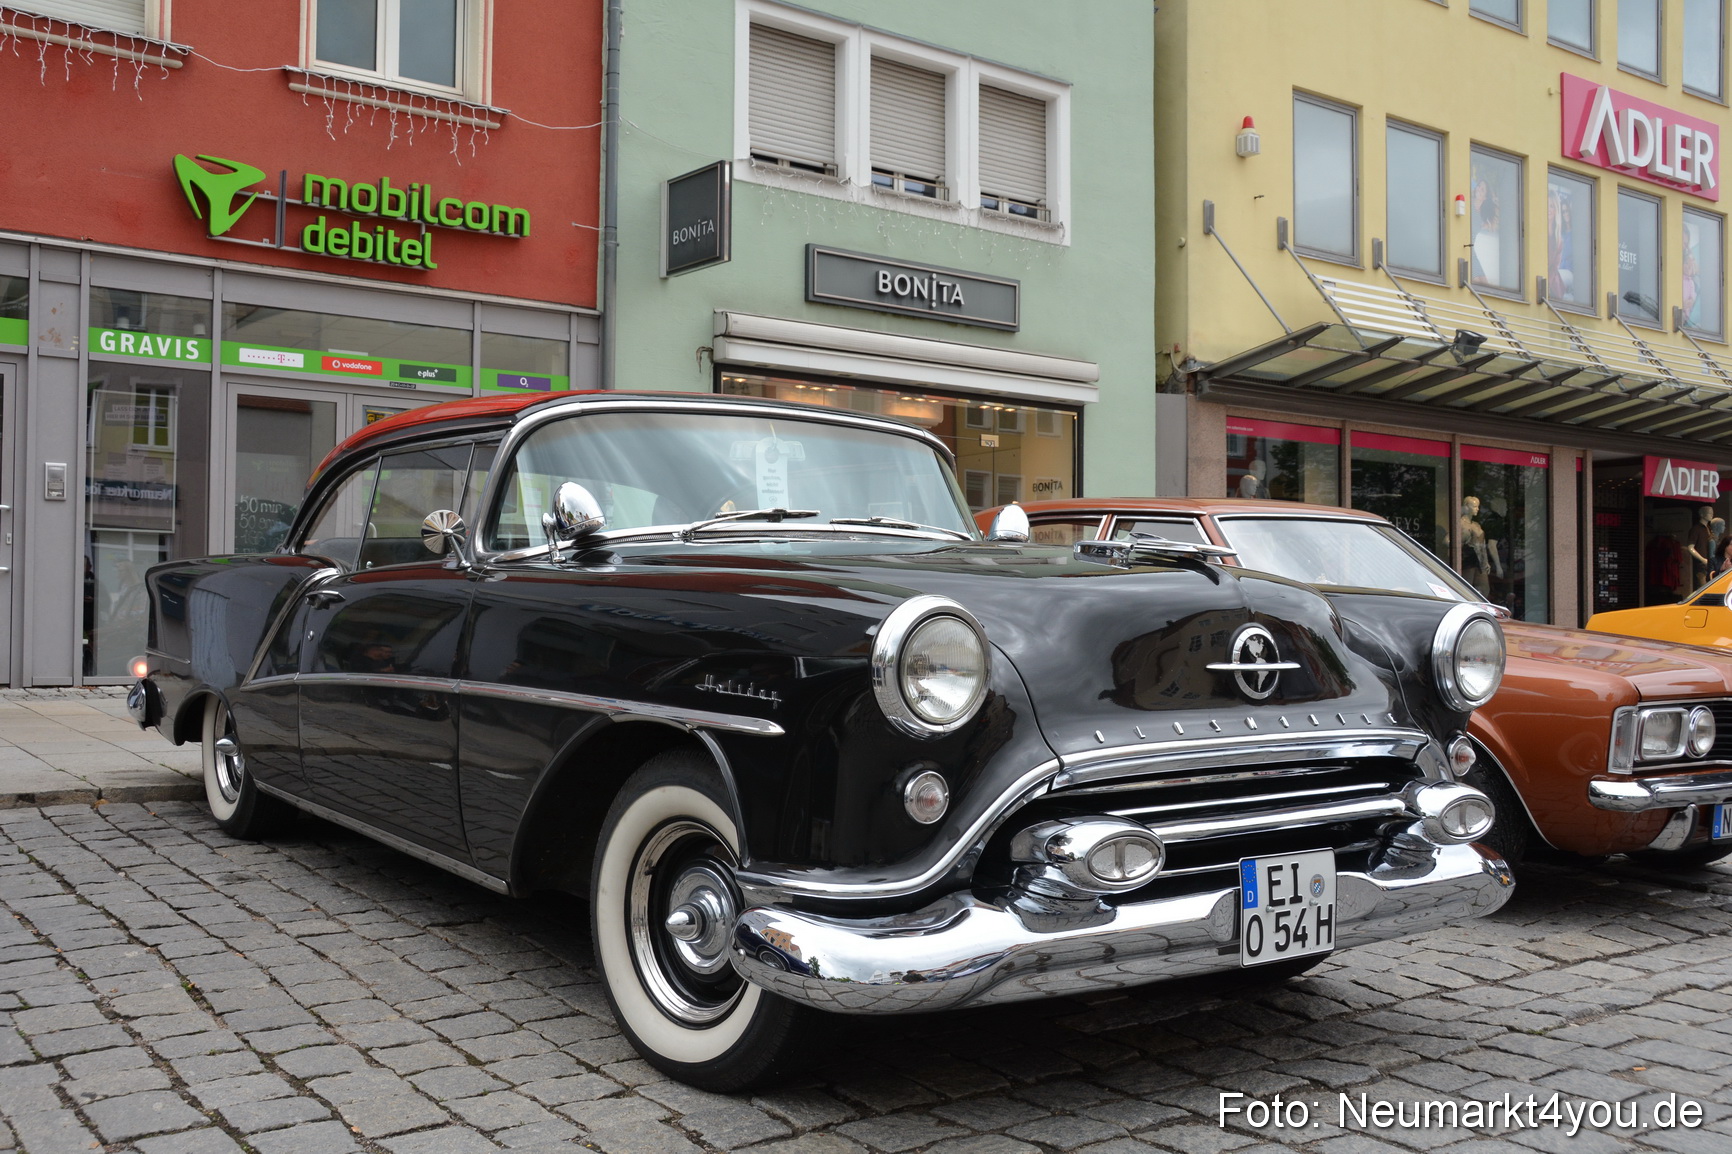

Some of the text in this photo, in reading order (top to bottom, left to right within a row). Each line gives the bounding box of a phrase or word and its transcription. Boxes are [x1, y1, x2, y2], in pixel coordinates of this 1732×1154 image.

[1579, 86, 1716, 189] ADLER
[302, 172, 531, 238] mobilcom
[302, 215, 438, 270] debitel
[672, 219, 715, 246] BONITA
[1619, 249, 1637, 265] SEITE
[876, 270, 965, 308] BONITA
[100, 331, 200, 360] GRAVIS
[341, 361, 373, 371] vodafone
[1530, 455, 1547, 465] ADLER
[1032, 479, 1064, 494] BONITA
[1651, 458, 1721, 500] ADLER
[1247, 862, 1303, 908] D EI
